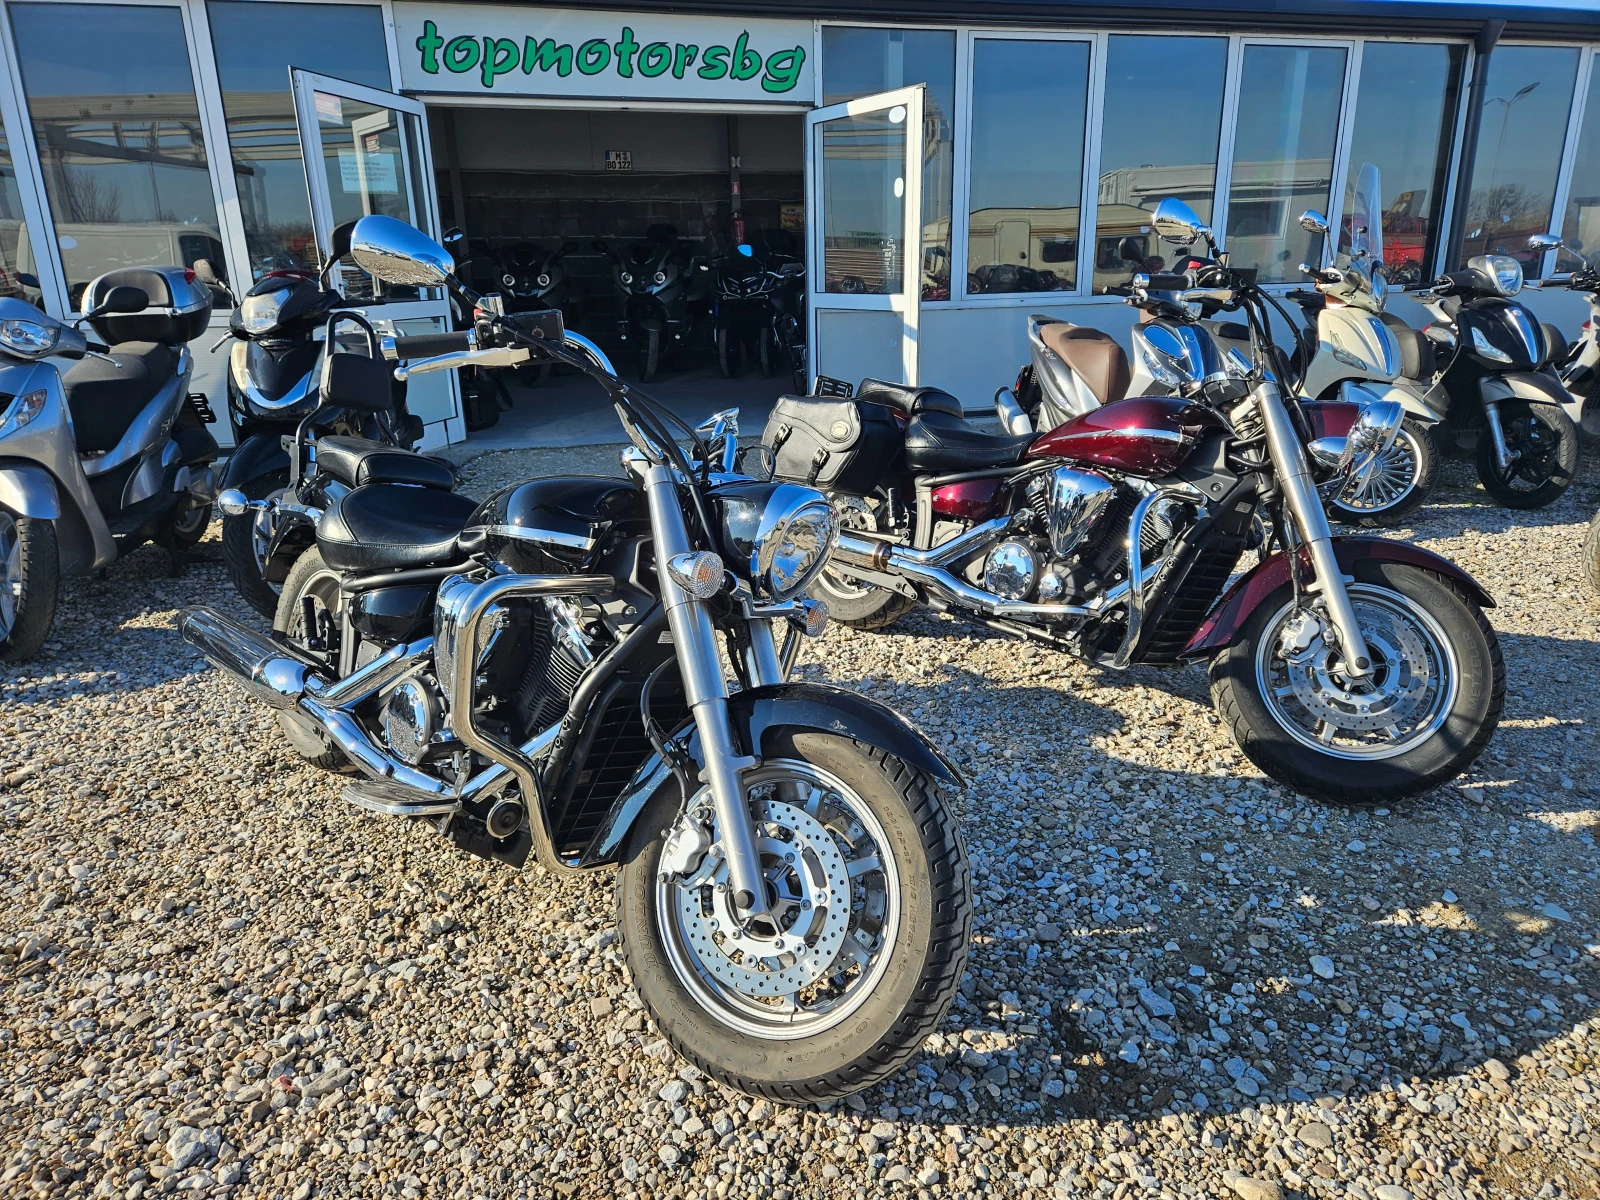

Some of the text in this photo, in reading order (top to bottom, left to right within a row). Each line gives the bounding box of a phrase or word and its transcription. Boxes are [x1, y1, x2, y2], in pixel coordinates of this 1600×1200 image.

[416, 20, 806, 93] topmotorsbg
[617, 161, 631, 169] 122
[1462, 629, 1483, 711] METZELER
[634, 864, 660, 969] DUNLOP
